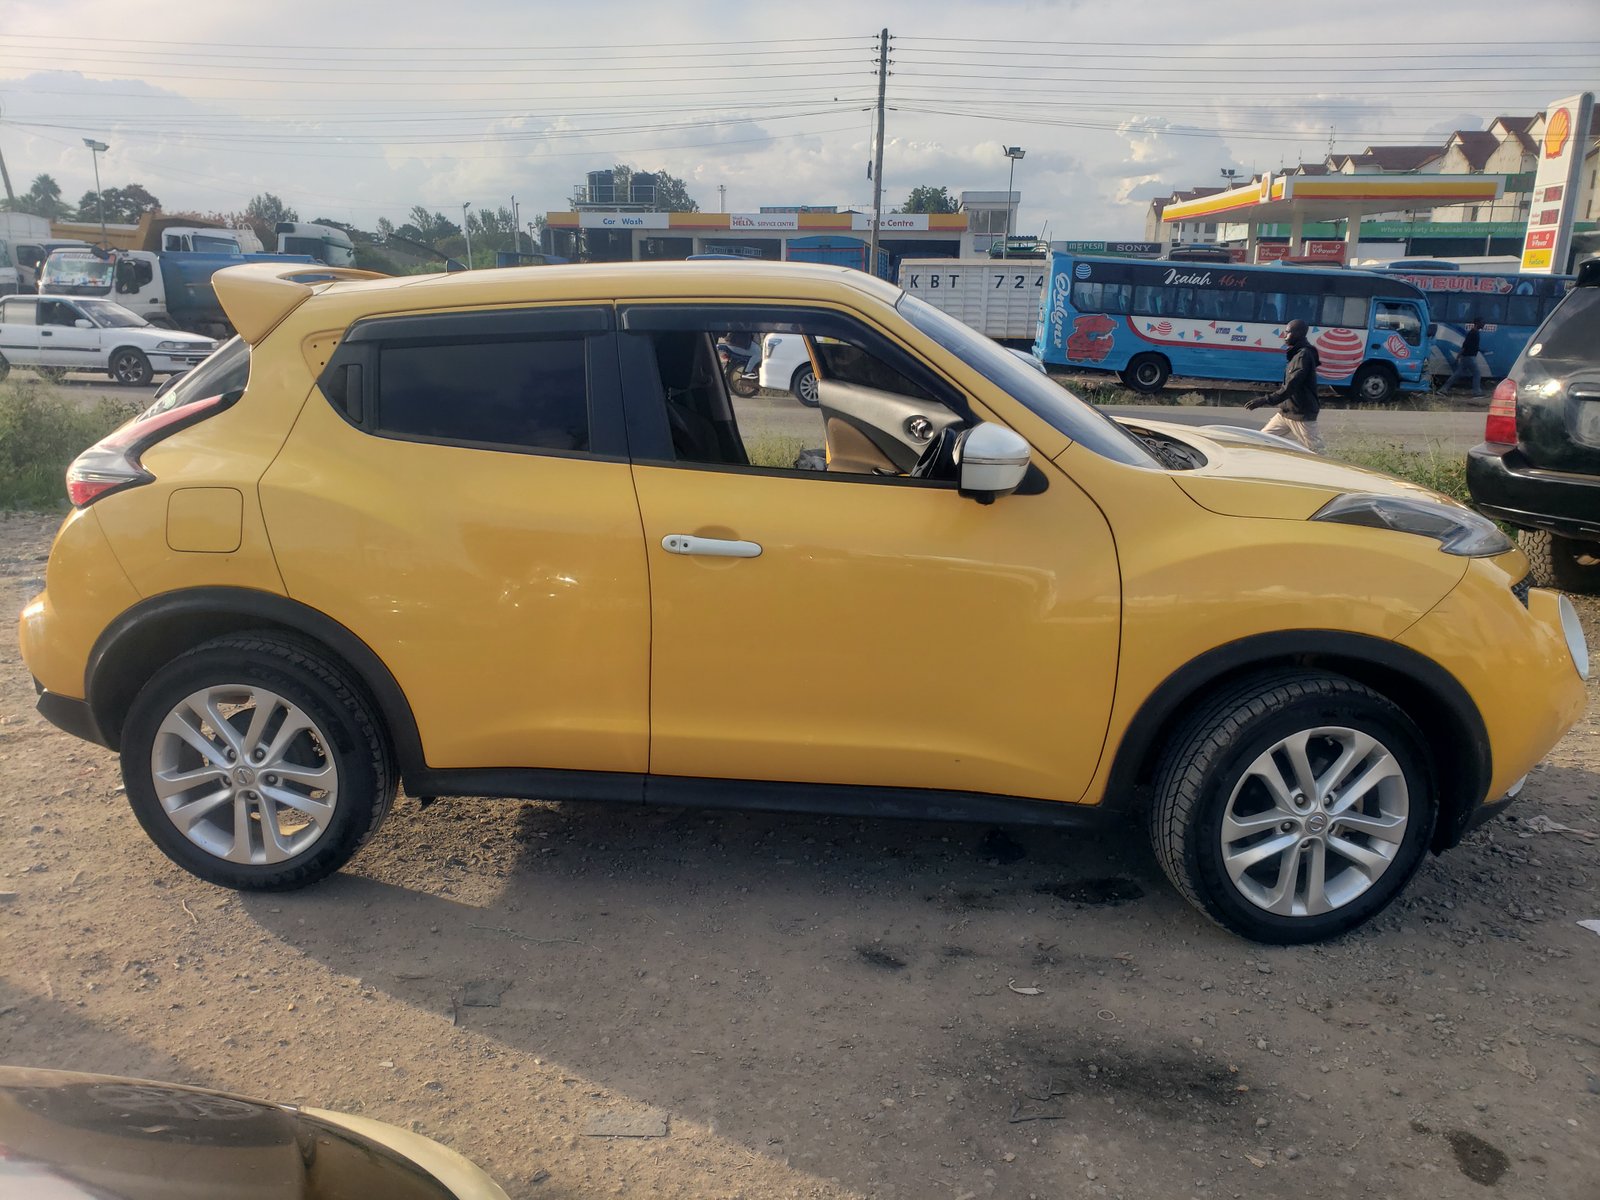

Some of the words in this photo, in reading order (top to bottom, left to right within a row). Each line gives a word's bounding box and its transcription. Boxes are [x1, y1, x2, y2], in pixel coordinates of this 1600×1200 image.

[603, 217, 616, 225] Car
[622, 217, 643, 225] Wash
[732, 219, 754, 227] HELIX
[866, 219, 885, 227] Te
[887, 219, 914, 227] Centre
[1116, 244, 1151, 252] SONY
[1163, 268, 1212, 285] Isaiah
